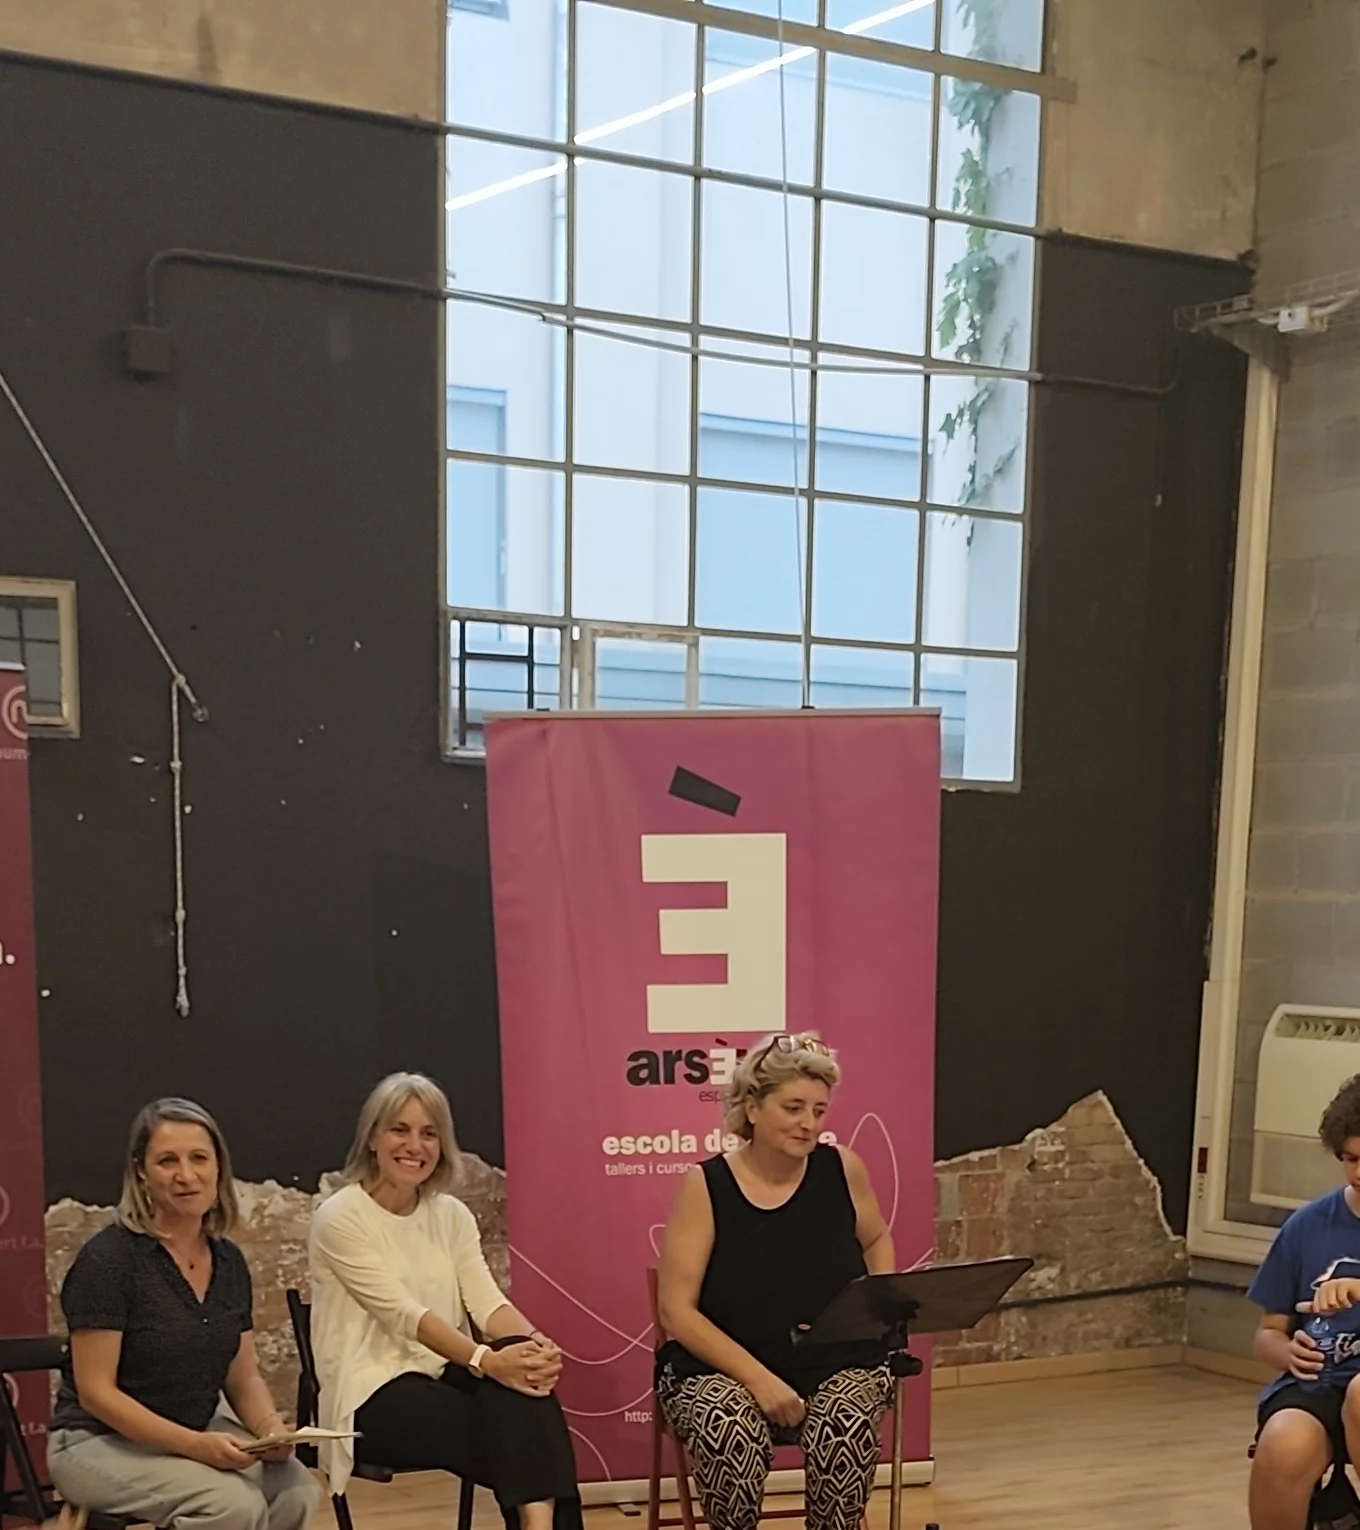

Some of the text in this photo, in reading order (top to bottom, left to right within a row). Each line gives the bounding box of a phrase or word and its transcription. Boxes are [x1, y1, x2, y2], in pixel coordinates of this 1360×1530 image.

[602, 1128, 739, 1155] escola de
[605, 1162, 646, 1176] tallers
[648, 1161, 653, 1174] i
[624, 1410, 653, 1424] http:
